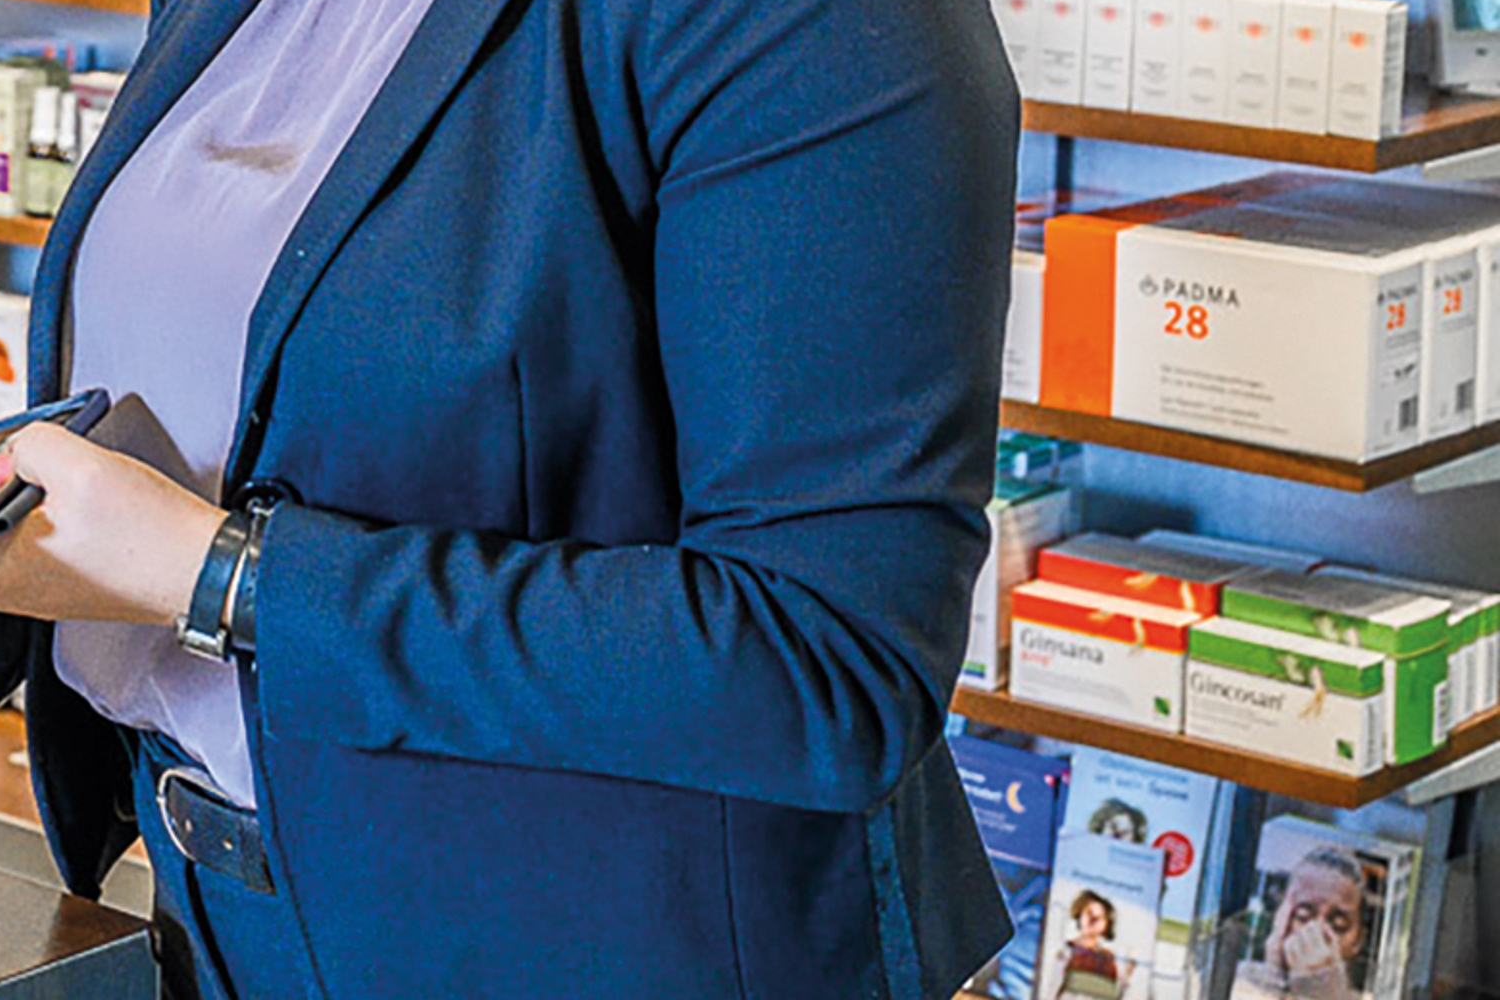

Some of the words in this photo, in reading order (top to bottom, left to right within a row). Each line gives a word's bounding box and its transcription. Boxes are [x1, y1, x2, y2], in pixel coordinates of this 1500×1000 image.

[1163, 277, 1240, 308] PADMA
[1164, 300, 1209, 340] 28
[1020, 627, 1104, 664] Ginsana
